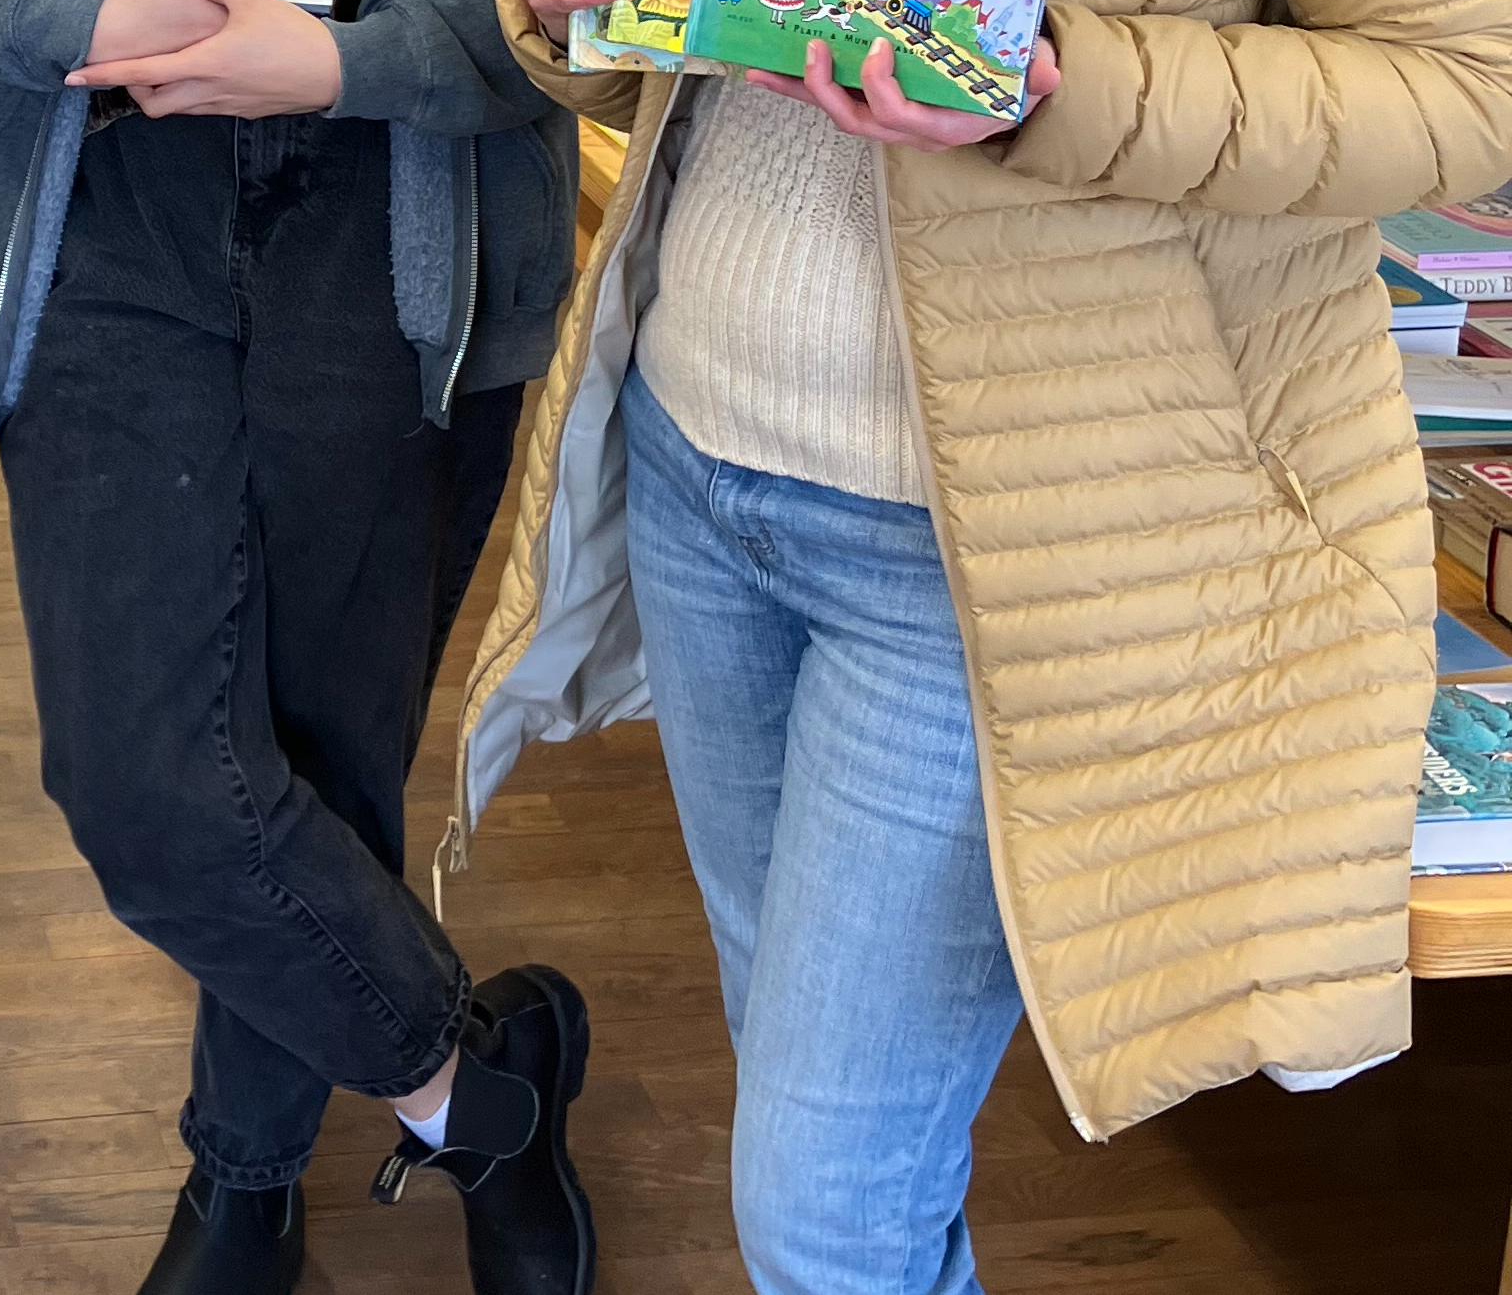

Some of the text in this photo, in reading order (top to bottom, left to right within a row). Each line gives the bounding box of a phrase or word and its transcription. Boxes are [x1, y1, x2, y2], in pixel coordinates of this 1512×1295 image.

[793, 24, 824, 38] PLATT
[844, 33, 873, 47] MUN
[894, 45, 927, 57] ASSIC
[1440, 276, 1497, 295] TEDDY
